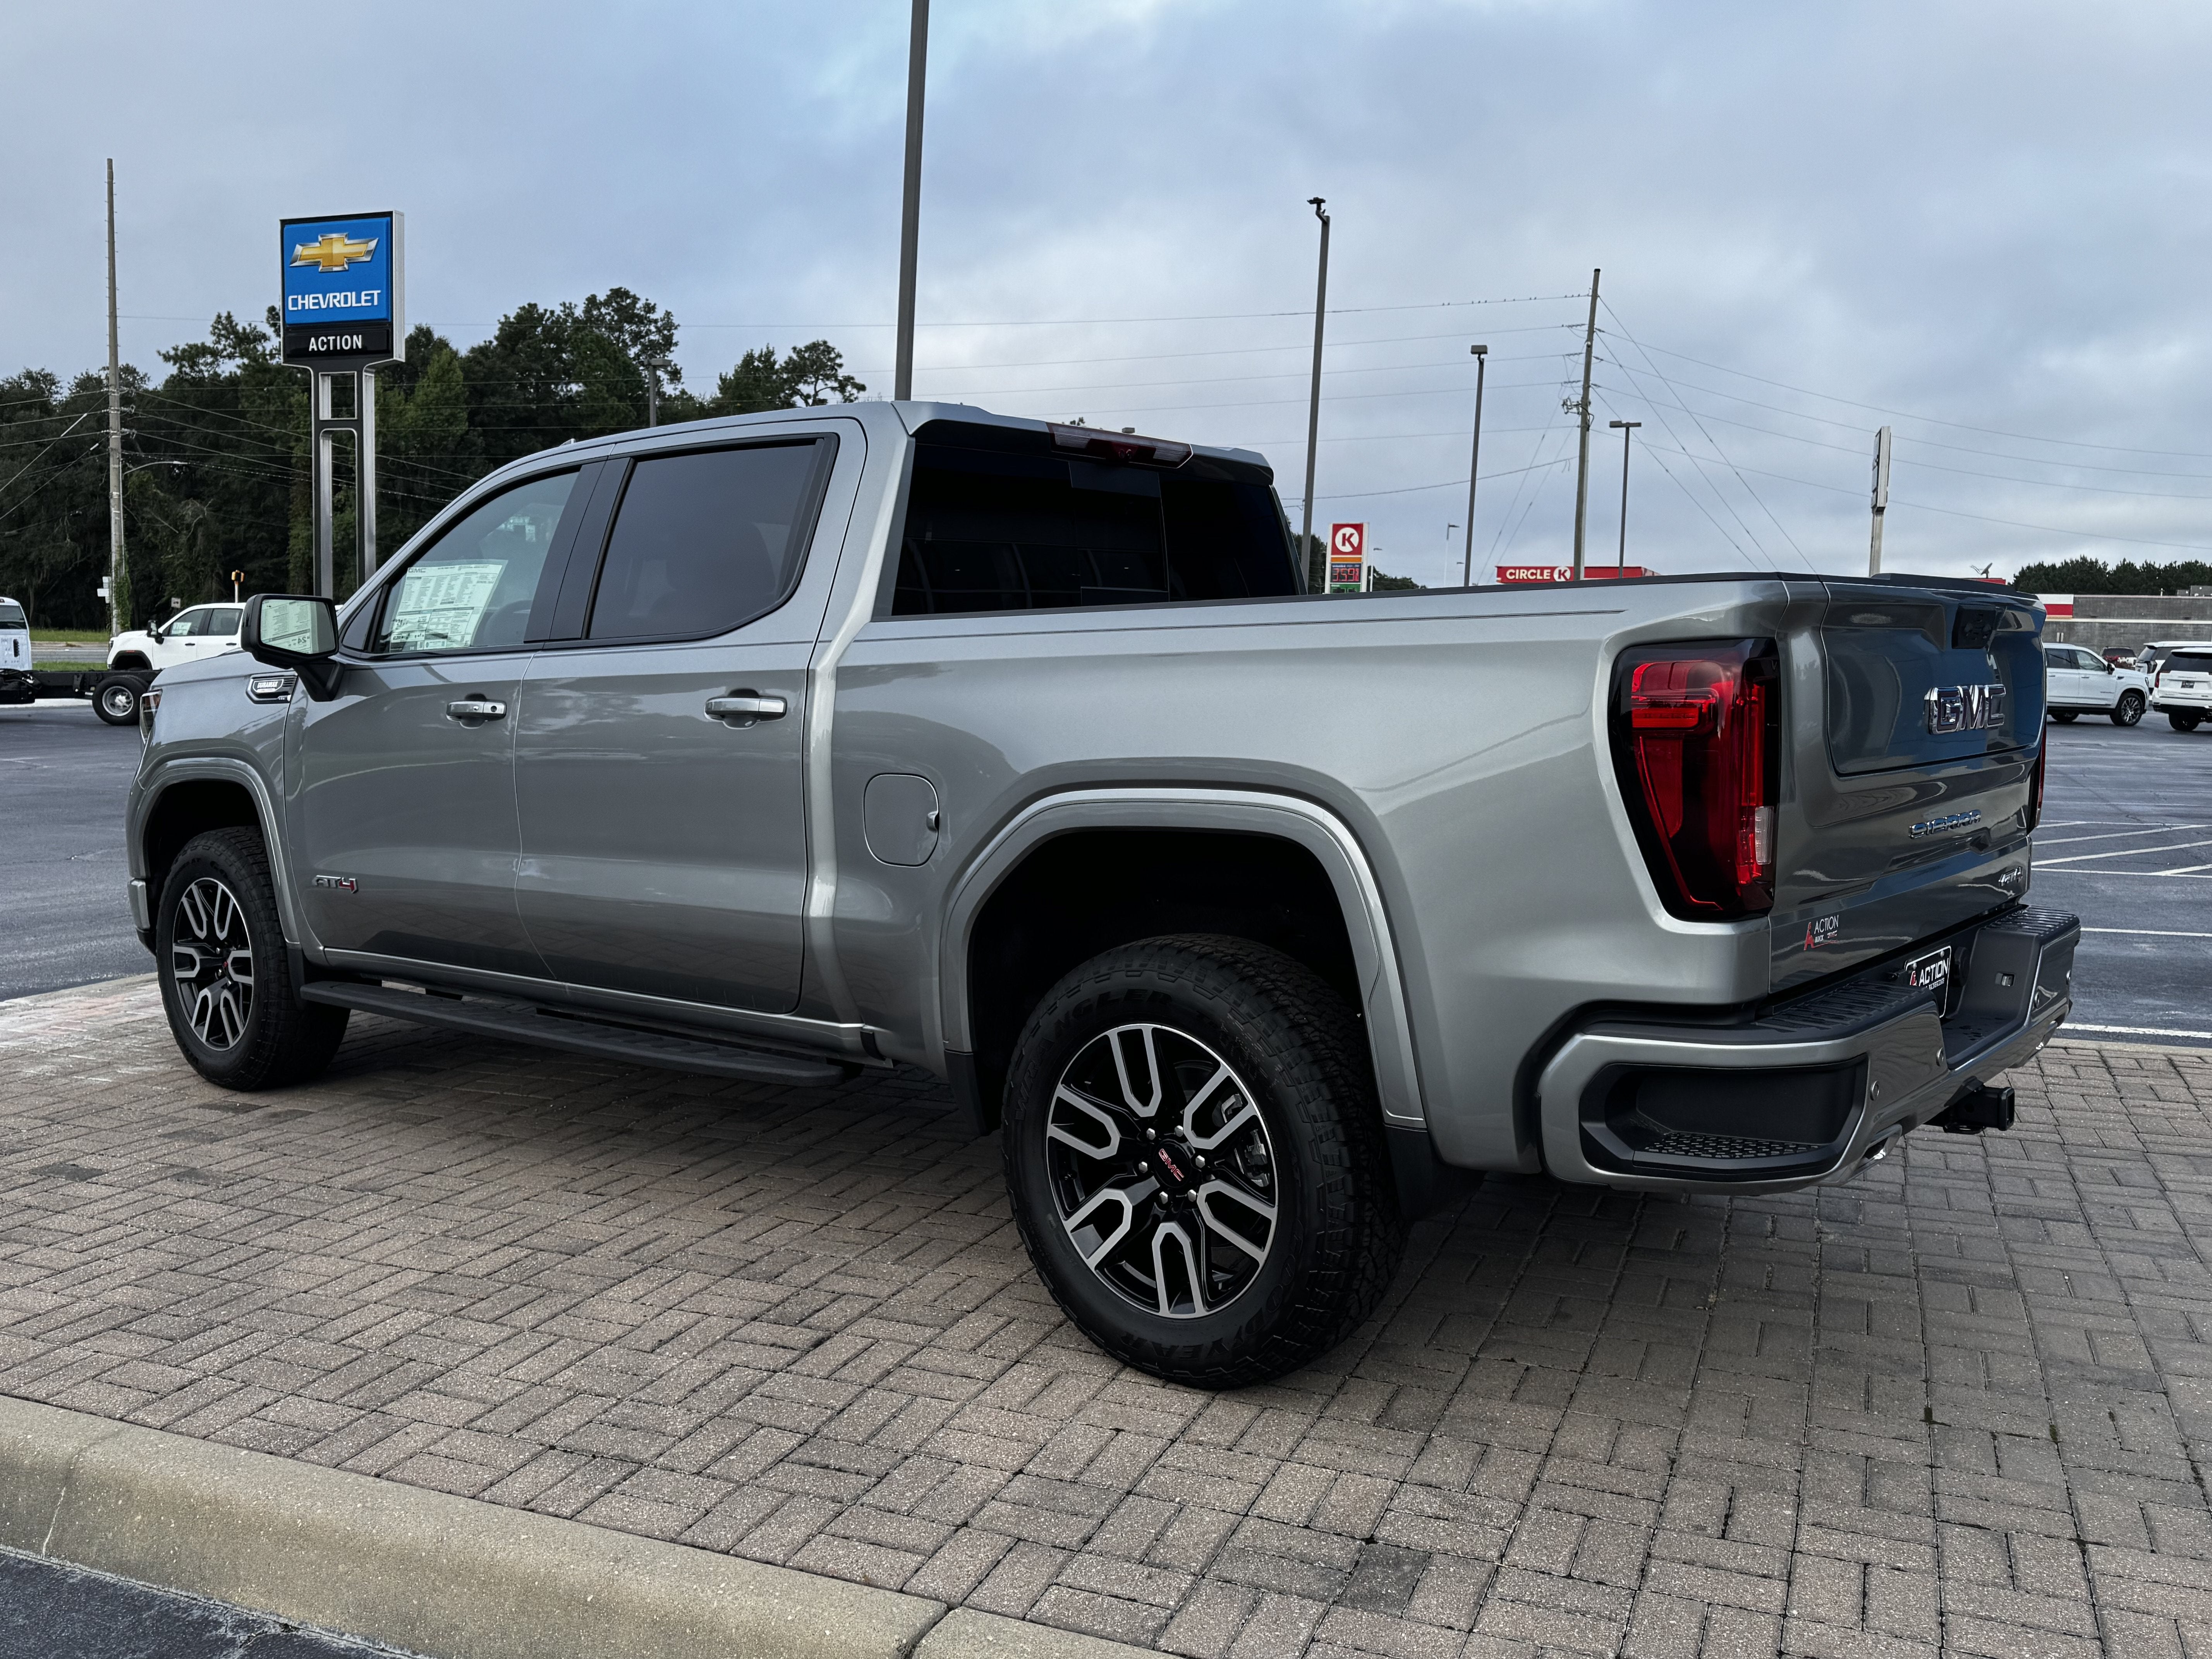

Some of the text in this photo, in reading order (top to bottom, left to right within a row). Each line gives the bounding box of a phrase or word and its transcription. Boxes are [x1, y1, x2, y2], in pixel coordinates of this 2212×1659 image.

[288, 290, 381, 310] CHEVROLET
[309, 335, 362, 351] ACTION
[1506, 569, 1551, 579] CIRCLE
[1923, 684, 2006, 735] GMC
[1908, 809, 1982, 839] SIERRA
[312, 875, 359, 894] AT4
[1814, 914, 1839, 934] ACTION
[1918, 957, 1949, 987] ACTION
[1158, 1148, 1185, 1181] GMC
